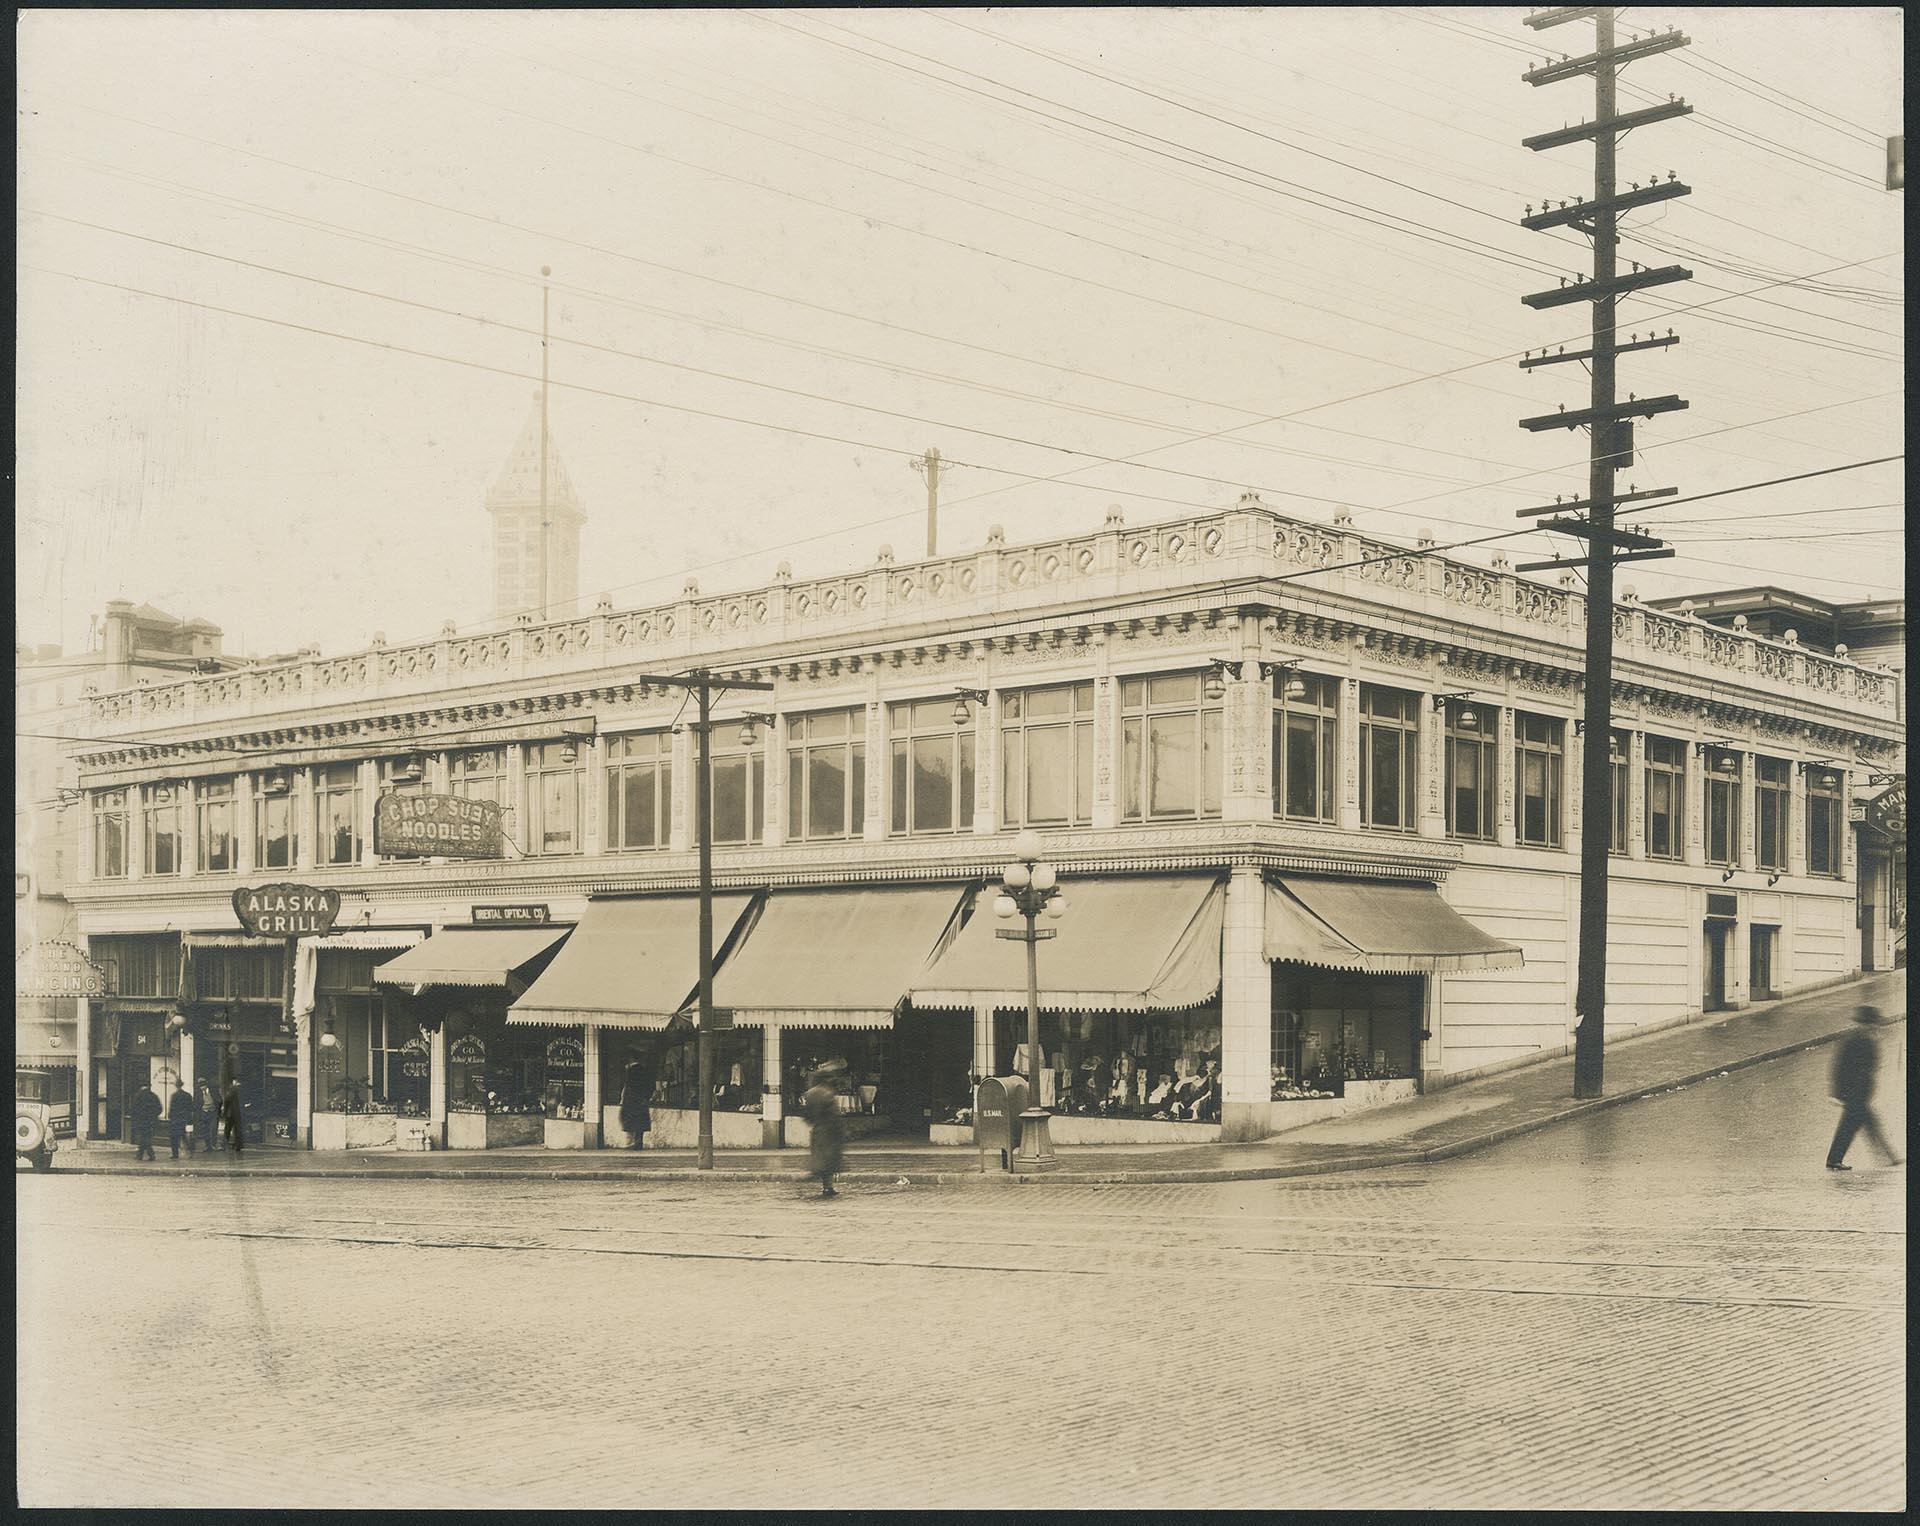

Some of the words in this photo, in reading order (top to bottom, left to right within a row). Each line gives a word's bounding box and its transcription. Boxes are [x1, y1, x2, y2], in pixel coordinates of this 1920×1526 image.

[470, 726, 517, 741] ENTRANCE
[525, 725, 541, 737] 315
[388, 797, 440, 821] CHOP
[448, 799, 495, 826] SUEY
[401, 820, 482, 841] NOODLES
[249, 895, 329, 912] ALASKA
[504, 908, 531, 919] OPTICAL
[258, 916, 320, 932] GRILL
